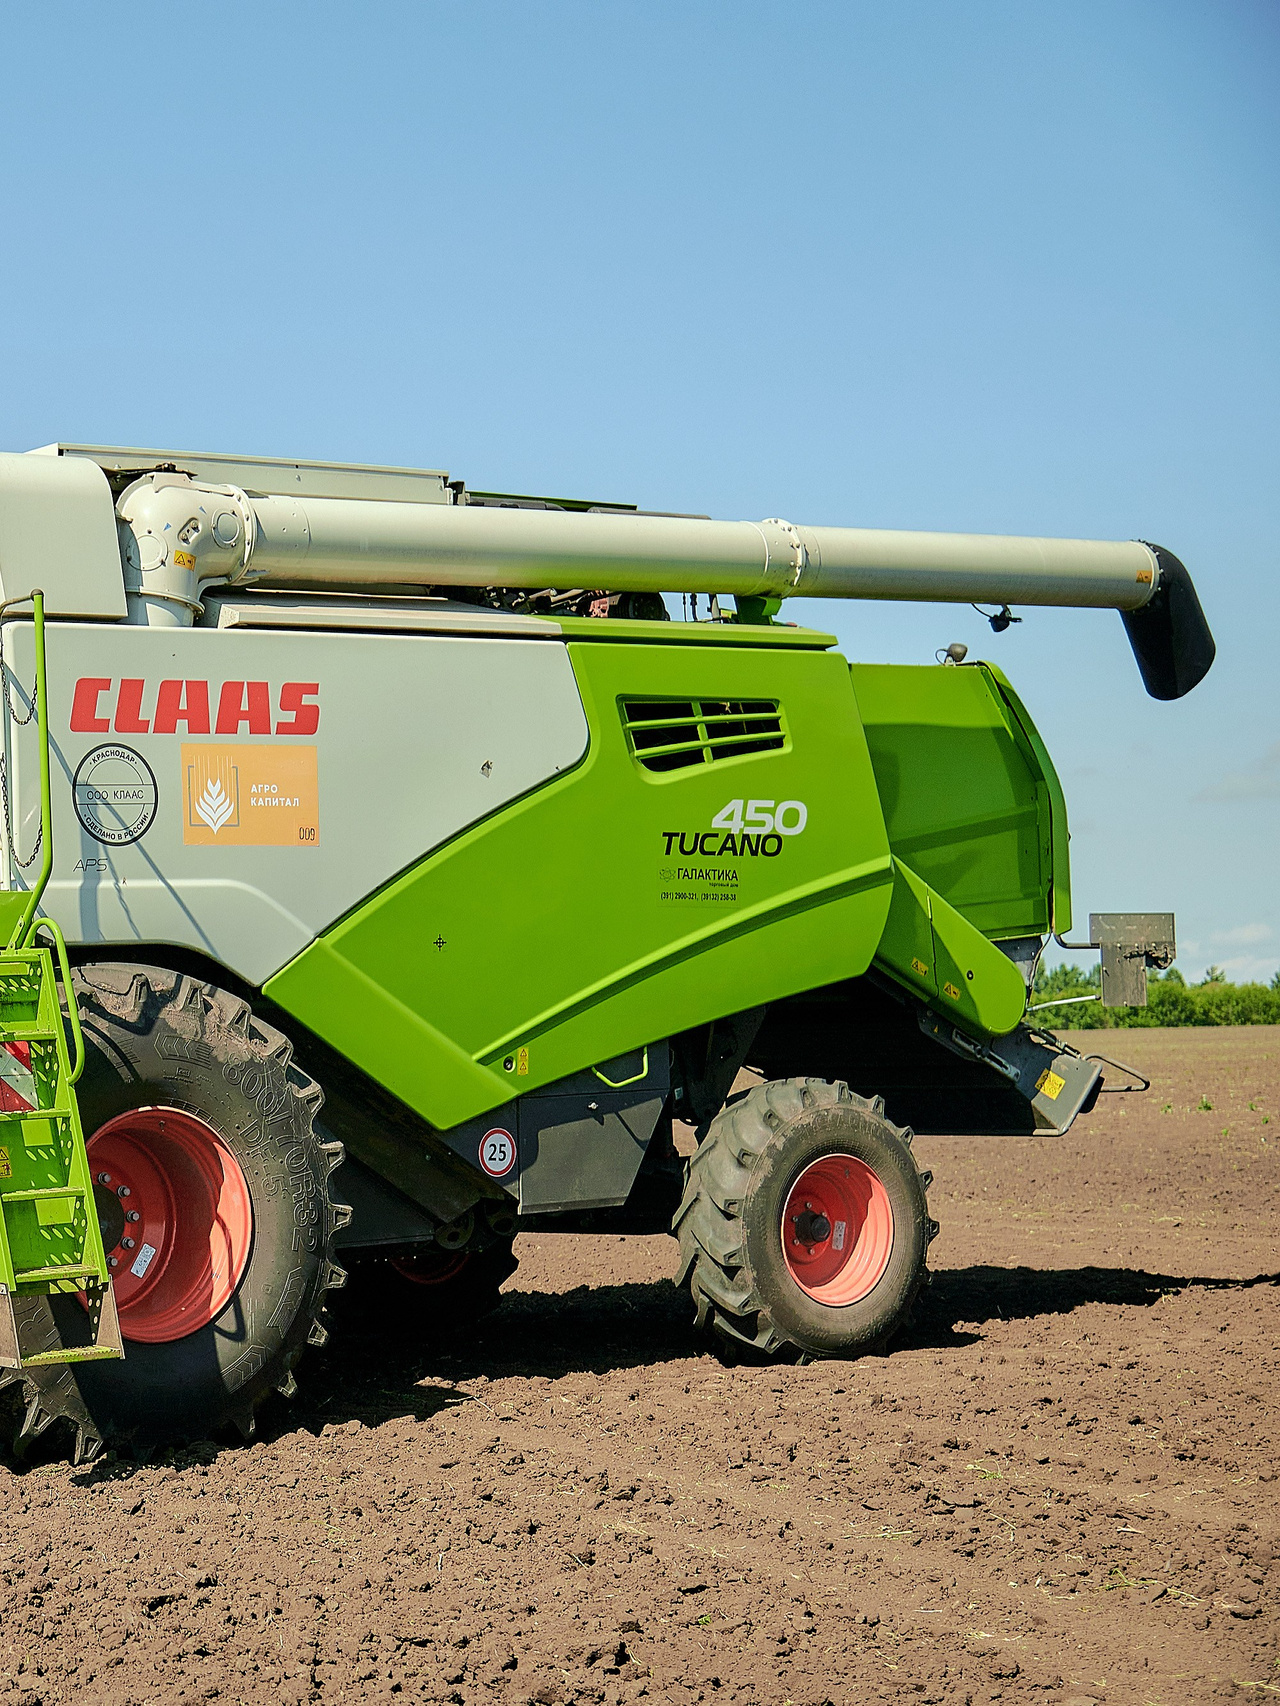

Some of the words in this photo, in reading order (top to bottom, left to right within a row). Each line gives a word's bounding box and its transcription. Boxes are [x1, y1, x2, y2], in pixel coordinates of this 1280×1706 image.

[69, 677, 321, 736] CLAAS
[91, 749, 136, 764] КРАСНОДАР
[86, 790, 109, 800] ООО
[113, 789, 144, 800] КЛААС
[250, 783, 279, 795] АГРО
[250, 796, 300, 808] КАПИТАЛ
[711, 798, 808, 836] 450
[85, 816, 116, 840] СДЕЛАНО
[123, 815, 149, 839] РОССИИ
[299, 826, 316, 841] 009
[661, 831, 783, 857] TUCANO
[73, 858, 108, 872] APS
[677, 867, 739, 881] ГАЛАКТИКА
[661, 891, 674, 901] (391)
[488, 1143, 507, 1162] 25
